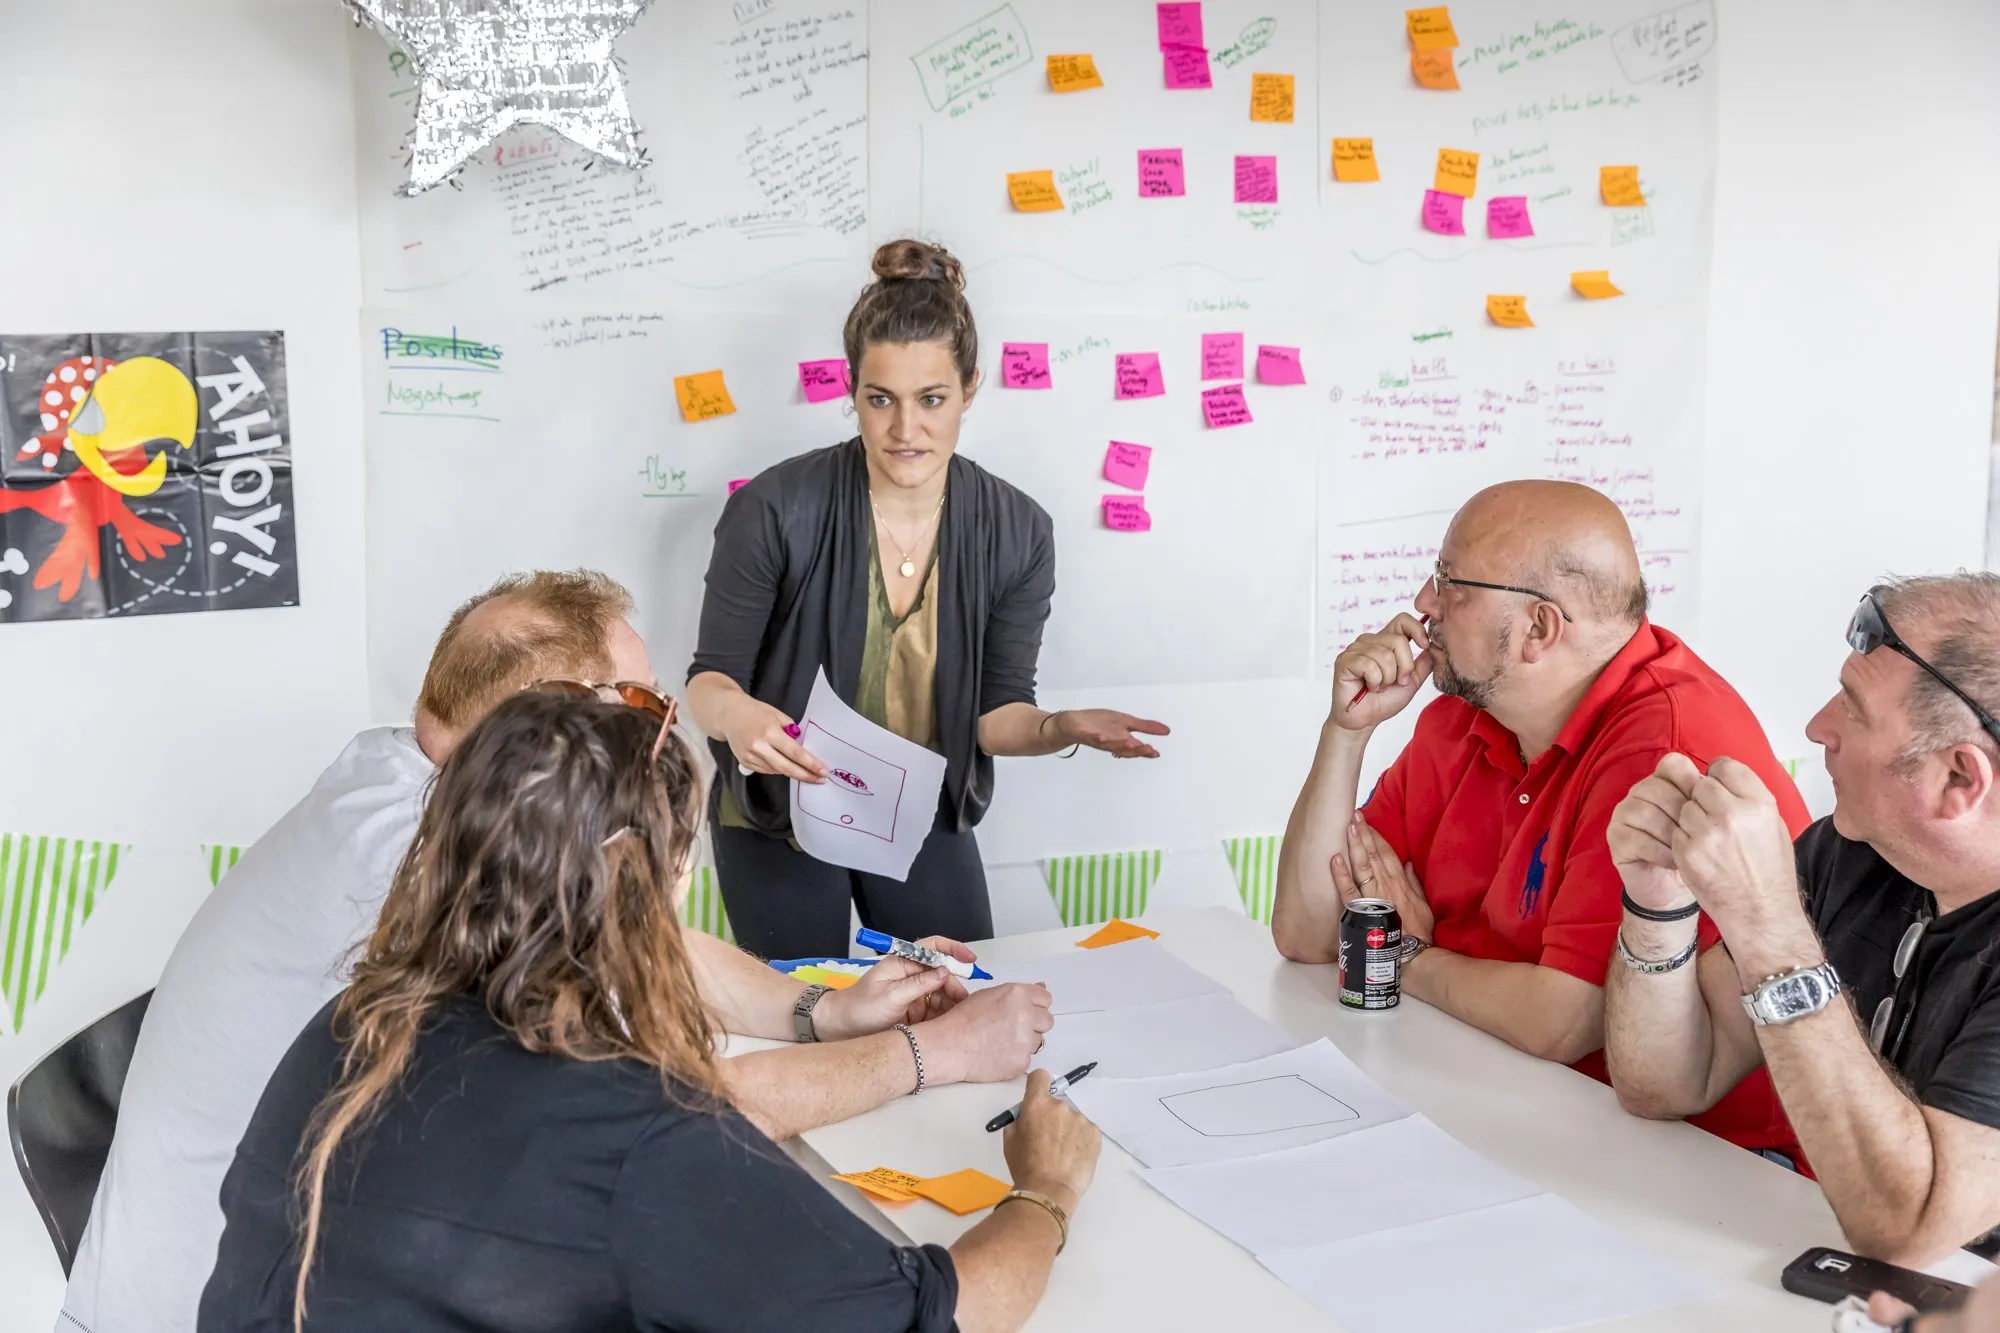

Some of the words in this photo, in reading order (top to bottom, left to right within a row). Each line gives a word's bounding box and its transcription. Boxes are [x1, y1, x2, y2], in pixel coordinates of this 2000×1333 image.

[380, 325, 504, 360] Positives
[386, 379, 483, 412] Negatives
[195, 354, 284, 577] AHOY!
